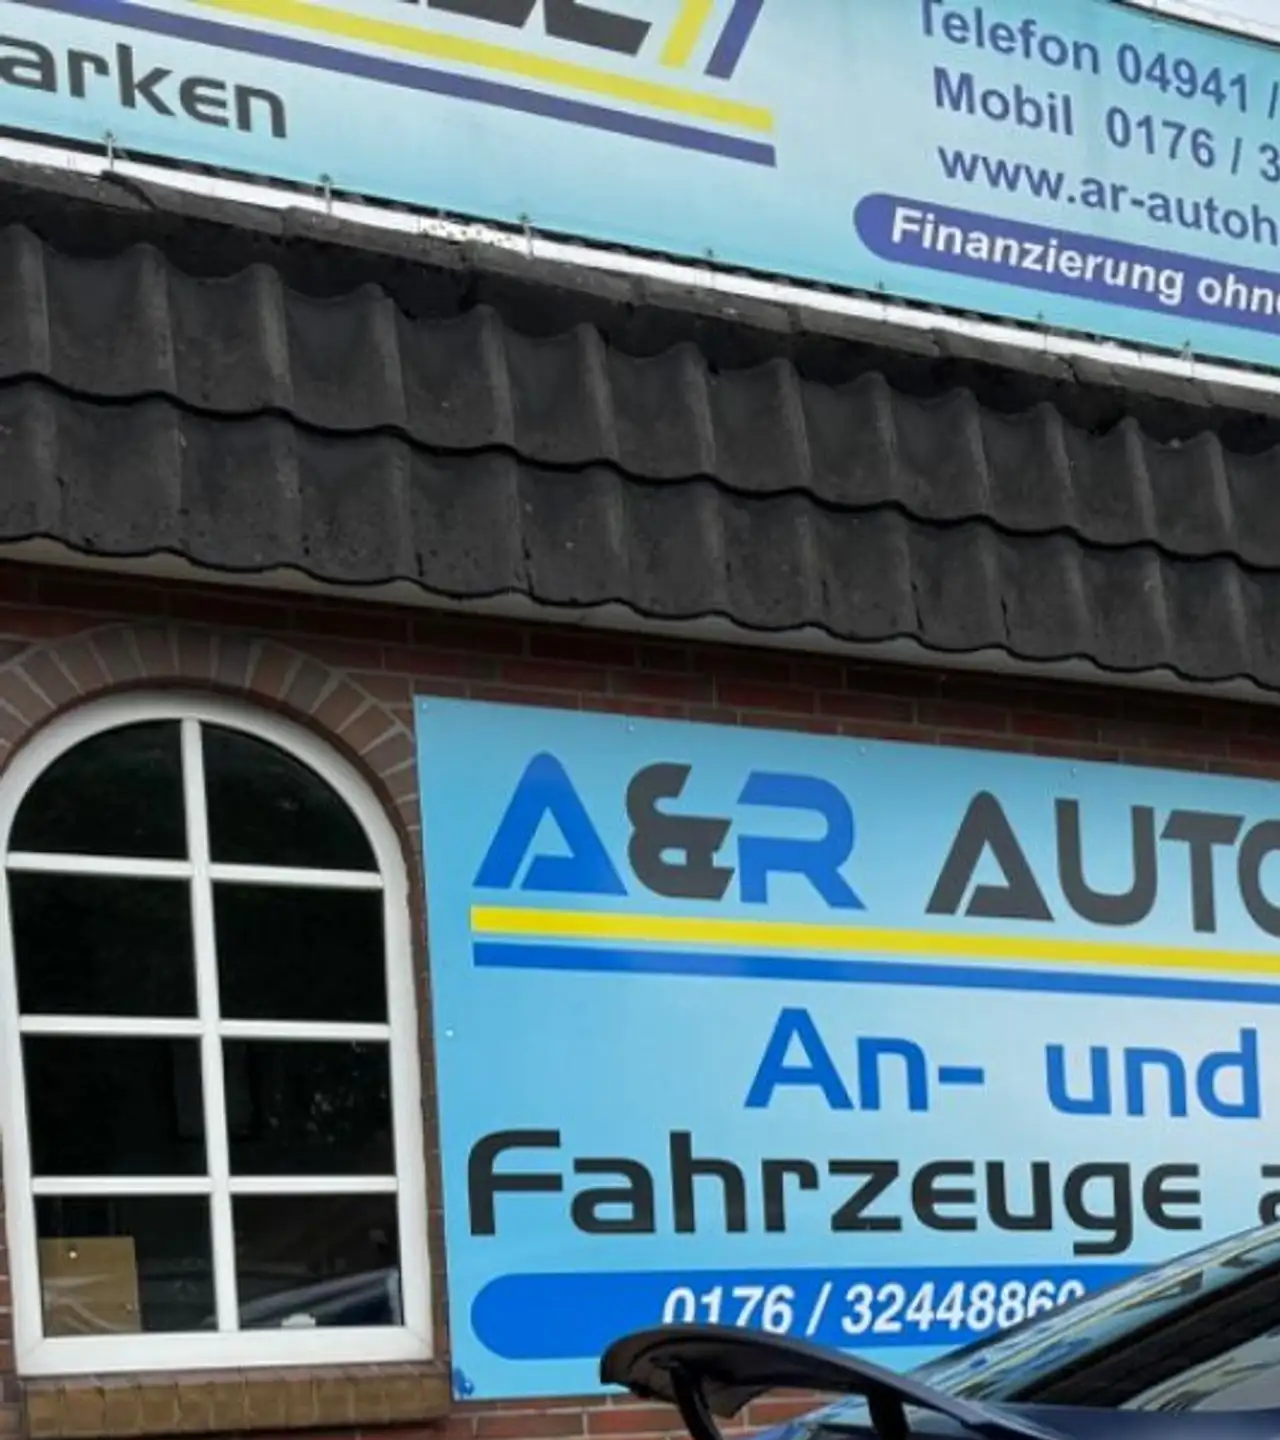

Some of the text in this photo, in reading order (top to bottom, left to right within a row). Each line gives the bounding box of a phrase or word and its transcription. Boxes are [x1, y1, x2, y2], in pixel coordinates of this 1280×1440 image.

[922, 0, 1100, 75] Telefon
[1117, 44, 1249, 115] 04941
[1268, 82, 1280, 119] /
[933, 65, 1073, 136] Mobil
[1105, 106, 1215, 168] 0176
[1230, 138, 1241, 175] /
[891, 206, 1184, 305] Finanzierung
[472, 751, 866, 910] A&R
[744, 1007, 985, 1112] An-
[1045, 1027, 1261, 1118] und
[467, 1129, 1202, 1257] Fahrzeuge
[663, 1286, 795, 1334] 0176
[805, 1282, 833, 1336] /
